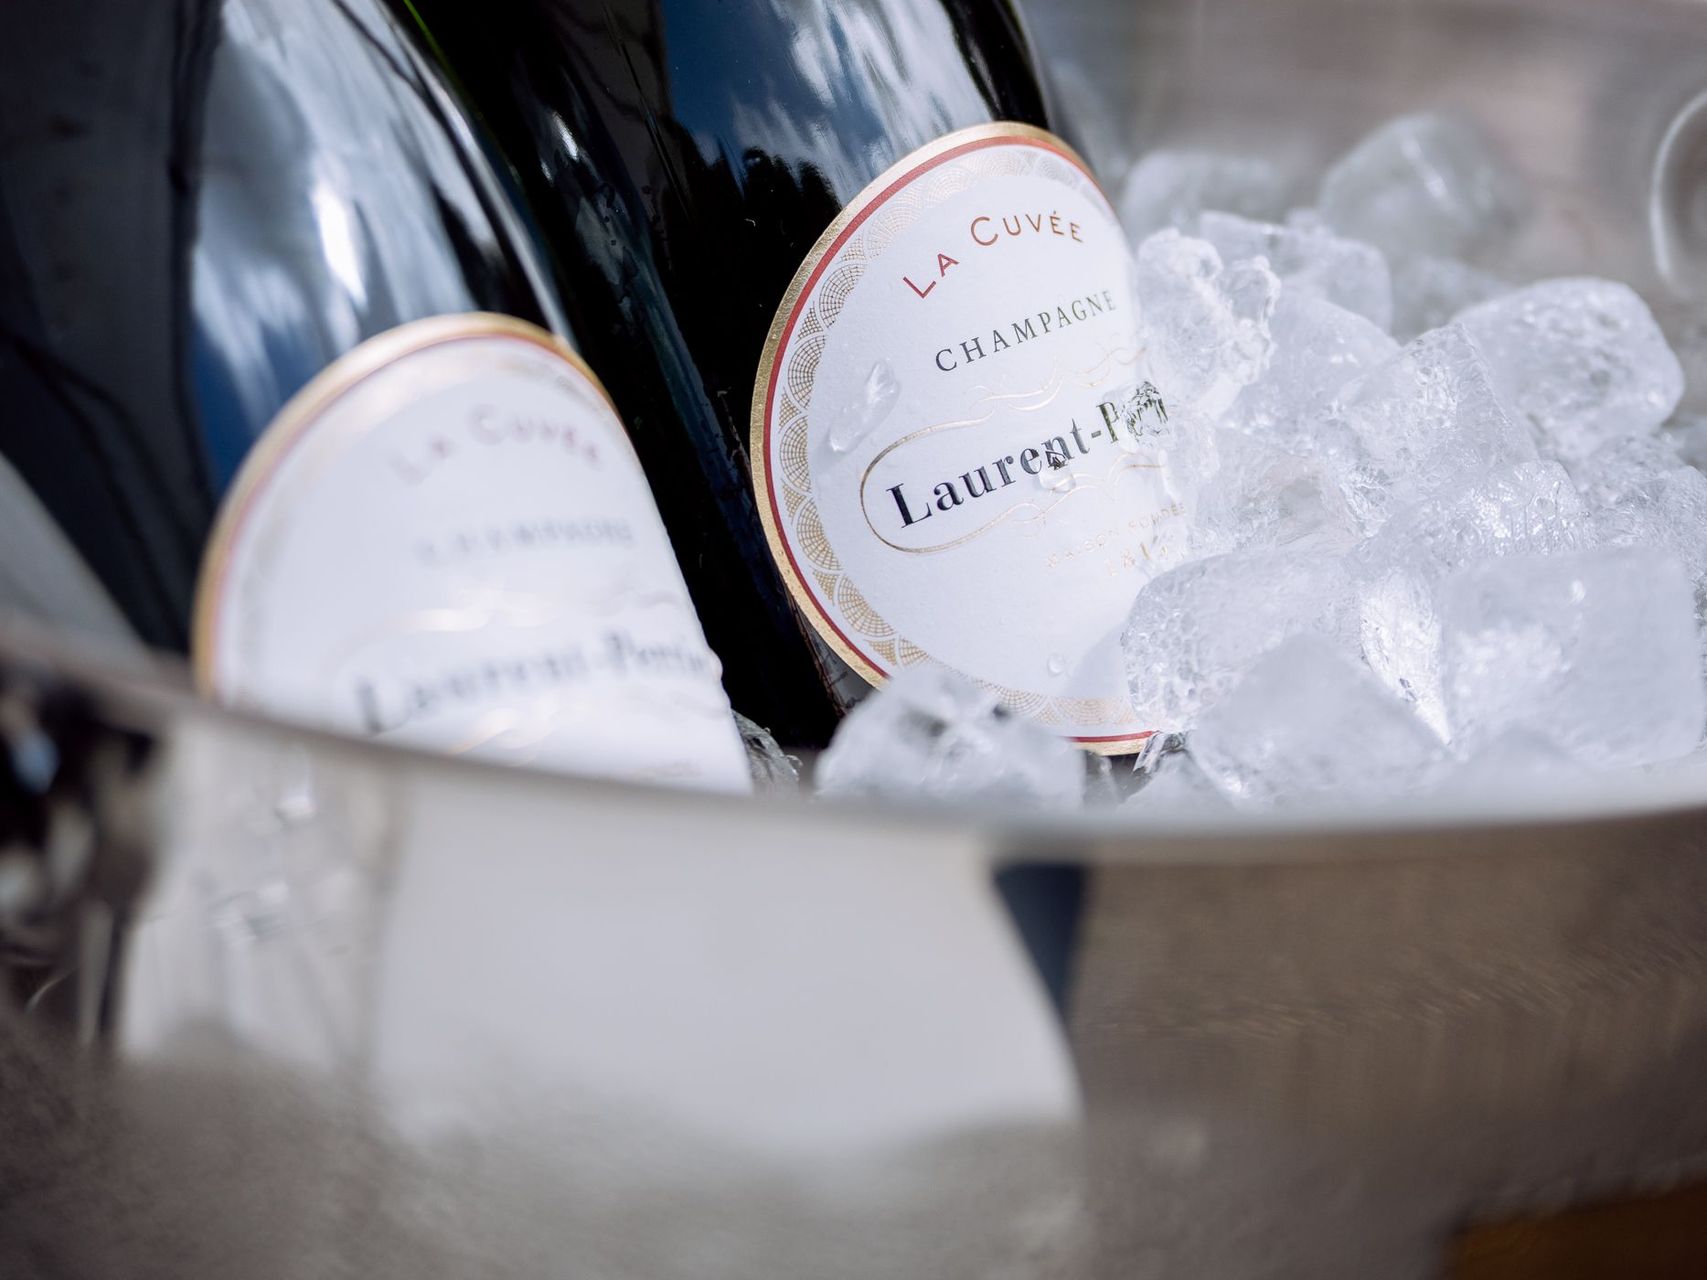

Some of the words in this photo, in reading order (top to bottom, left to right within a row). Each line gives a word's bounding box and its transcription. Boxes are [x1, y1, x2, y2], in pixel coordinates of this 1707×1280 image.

[902, 252, 960, 299] LA
[970, 209, 1084, 247] CUVÉE
[934, 289, 1117, 372] CHAMPAGNE
